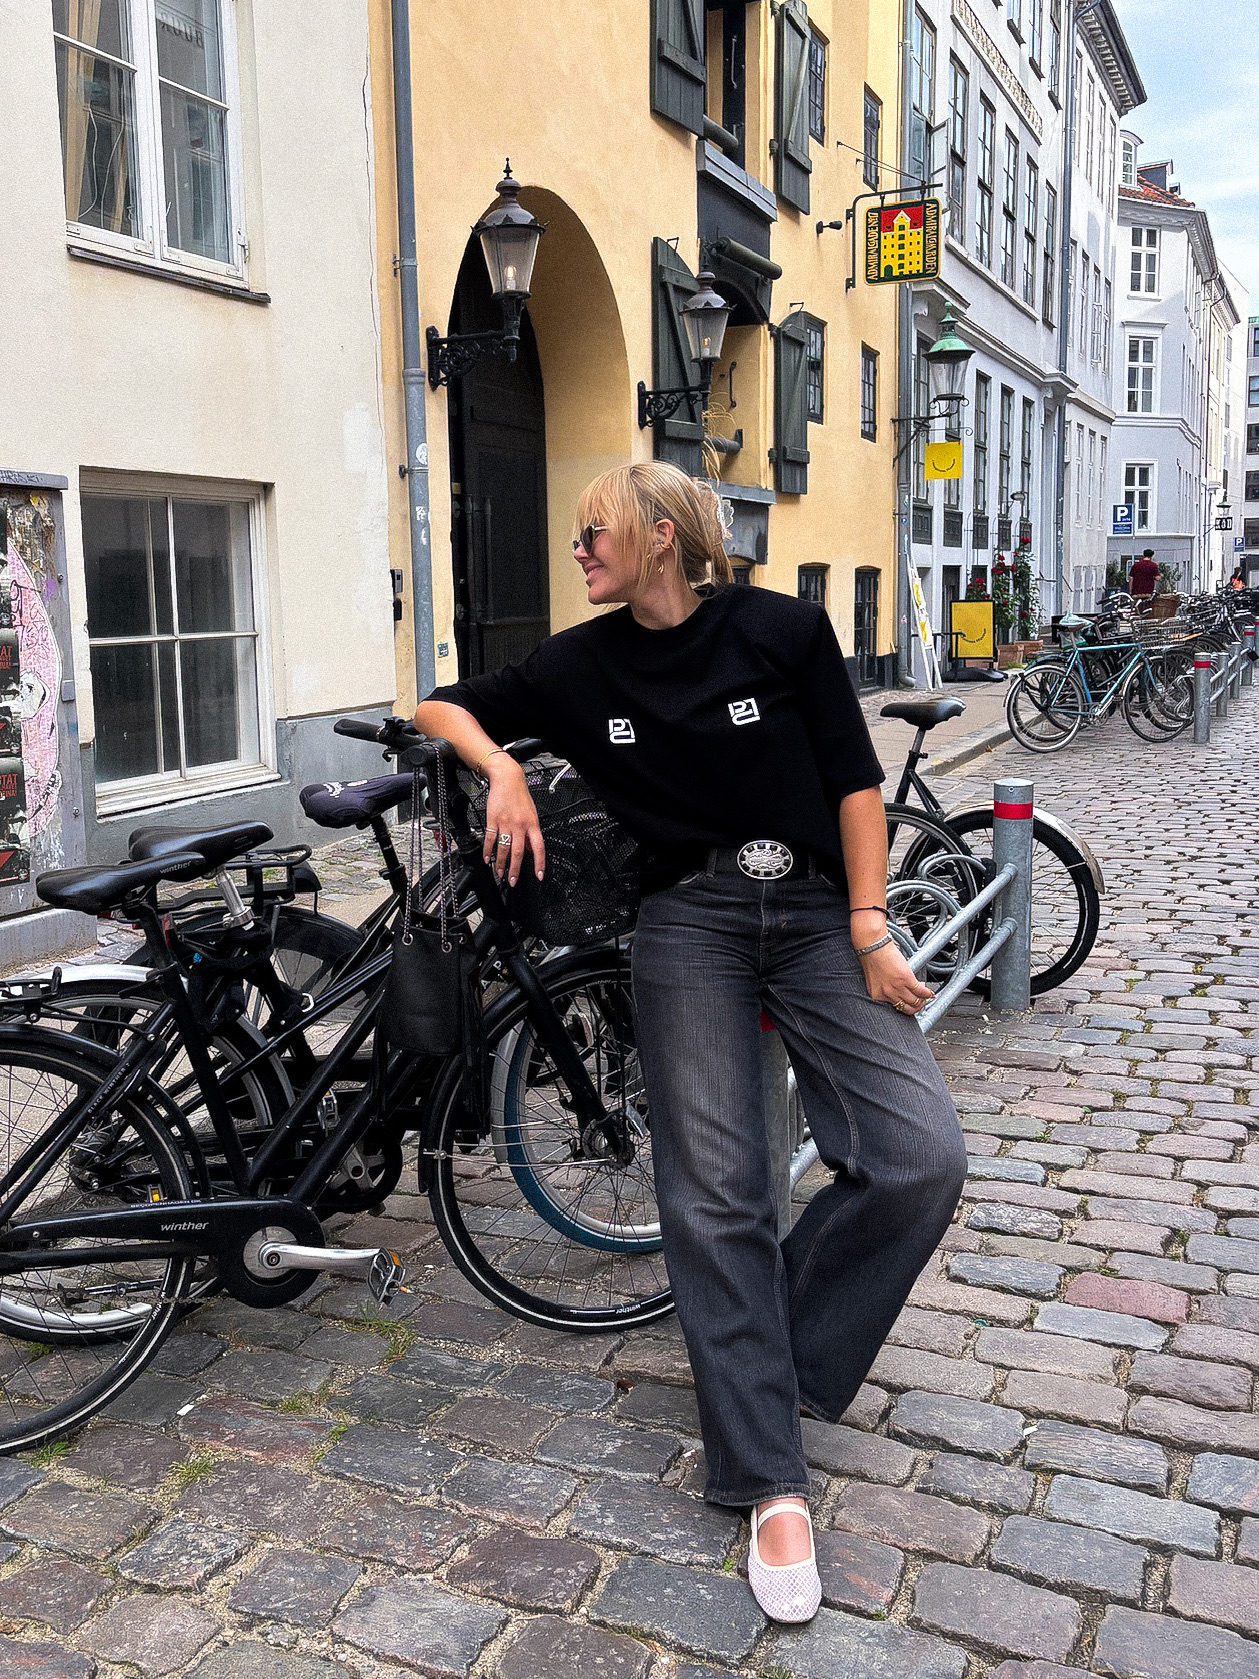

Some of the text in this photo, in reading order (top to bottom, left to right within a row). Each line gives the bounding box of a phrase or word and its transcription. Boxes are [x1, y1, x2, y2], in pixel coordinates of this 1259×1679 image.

[1117, 507, 1128, 521] P
[1236, 538, 1242, 546] P
[160, 861, 191, 874] winther
[161, 1222, 209, 1231] winther
